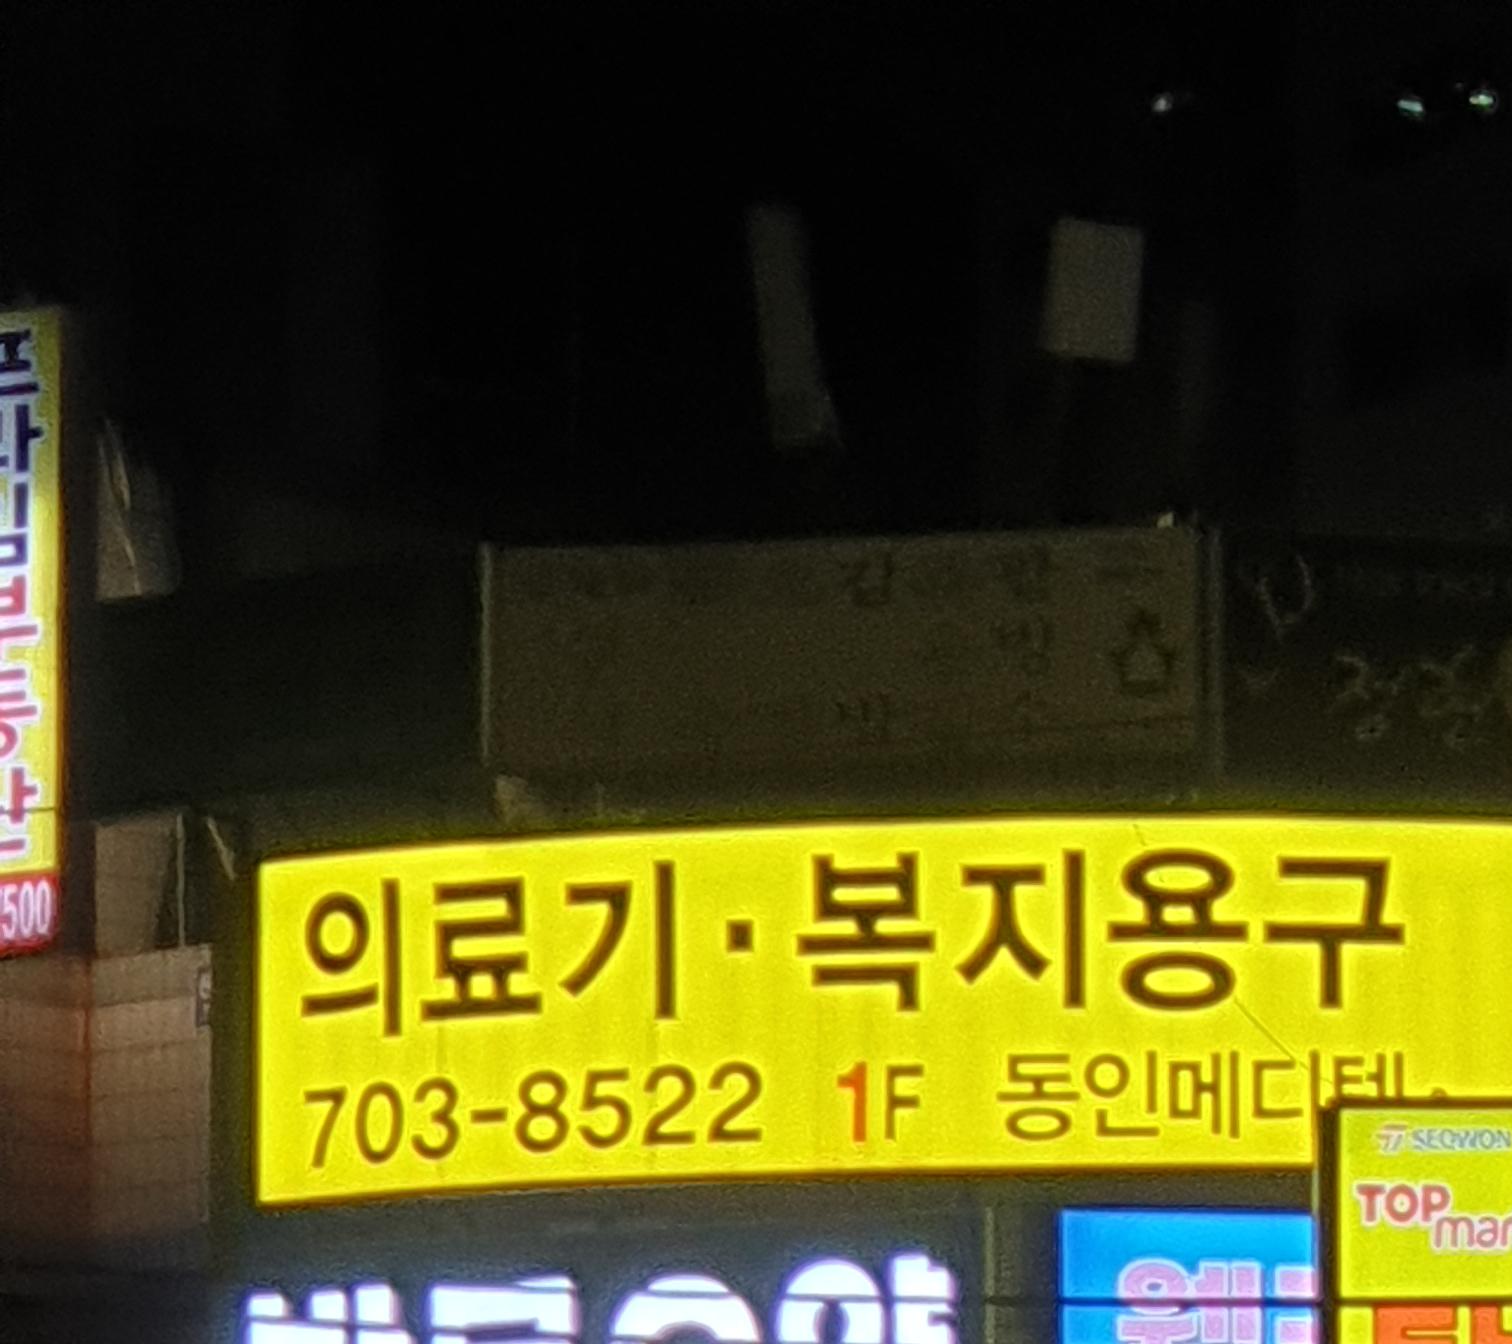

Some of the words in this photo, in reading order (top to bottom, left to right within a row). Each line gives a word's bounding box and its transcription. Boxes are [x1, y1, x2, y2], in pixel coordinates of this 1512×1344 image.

[302, 1060, 763, 1168] 703-8522
[836, 1060, 925, 1142] 1F
[1356, 1183, 1450, 1223] TOP
